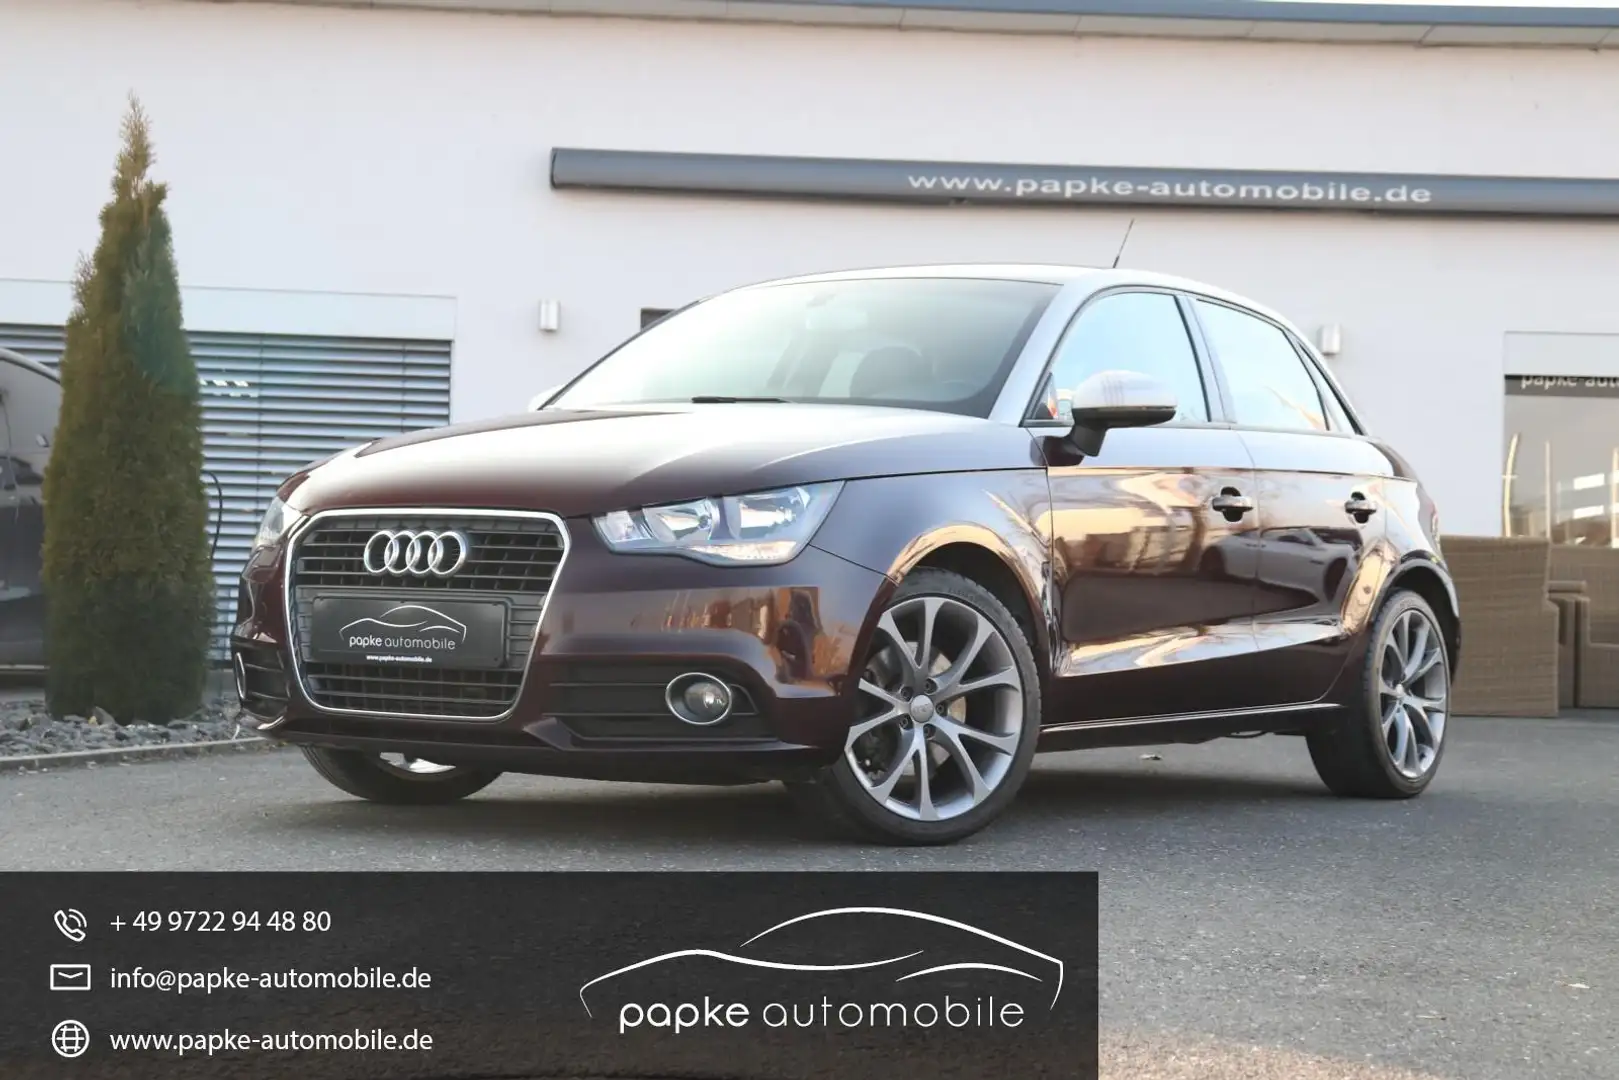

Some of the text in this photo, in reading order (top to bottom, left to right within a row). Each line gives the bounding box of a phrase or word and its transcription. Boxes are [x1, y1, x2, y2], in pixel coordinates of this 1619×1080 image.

[908, 174, 1432, 204] www.papke-automobile.de
[1520, 375, 1619, 389] papke-aut
[349, 635, 456, 650] papke automobile
